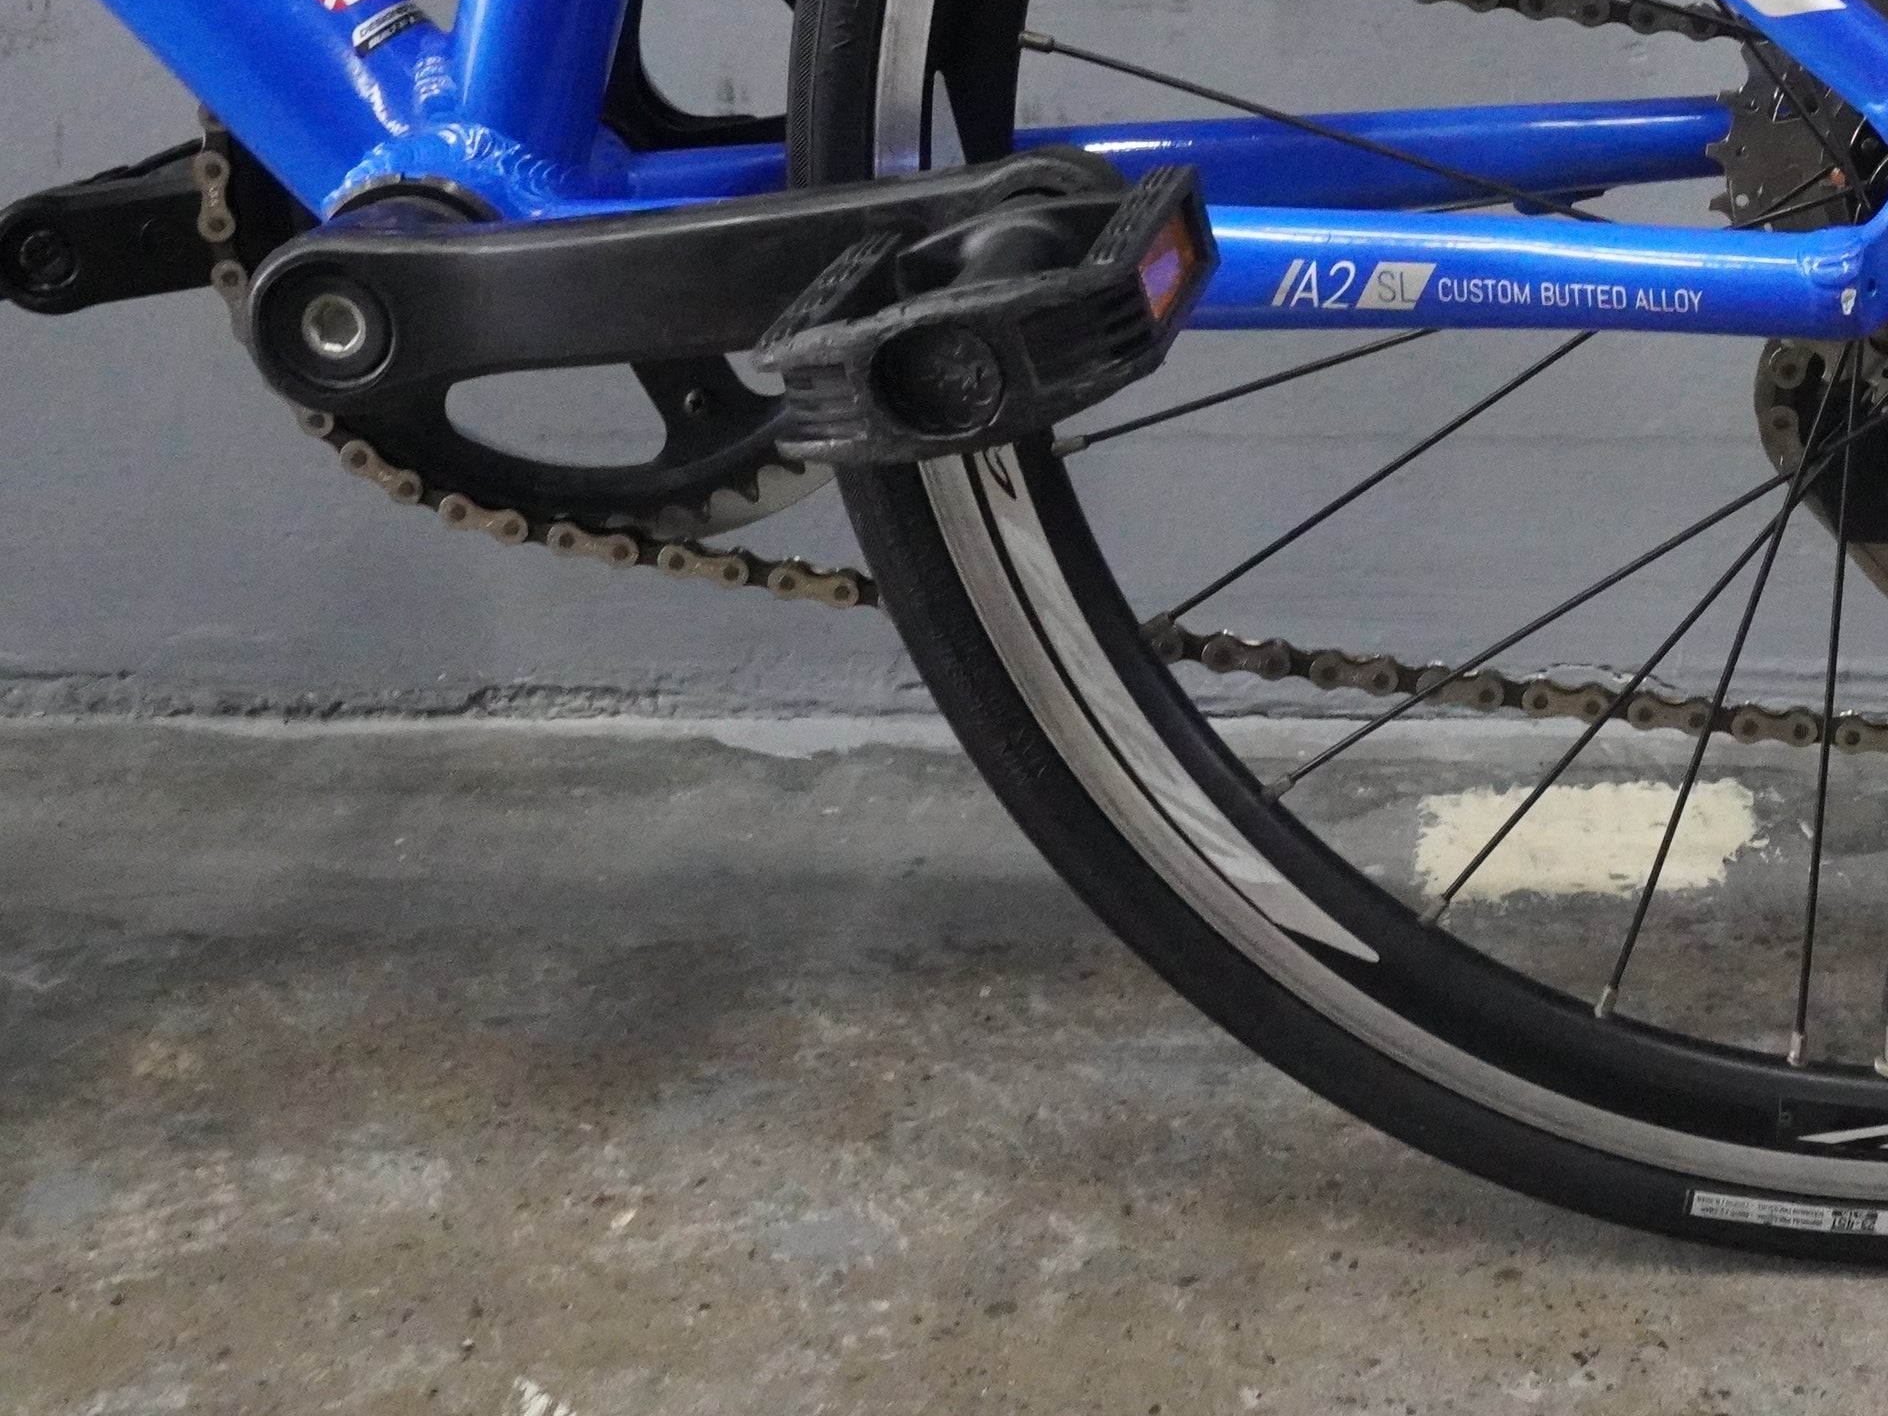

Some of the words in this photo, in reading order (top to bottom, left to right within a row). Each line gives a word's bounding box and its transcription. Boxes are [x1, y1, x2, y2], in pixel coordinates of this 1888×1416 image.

[1376, 270, 1419, 303] SL
[1437, 276, 1531, 305] CUSTOM
[1540, 281, 1628, 310] BUTTED
[1635, 287, 1704, 314] ALLOY
